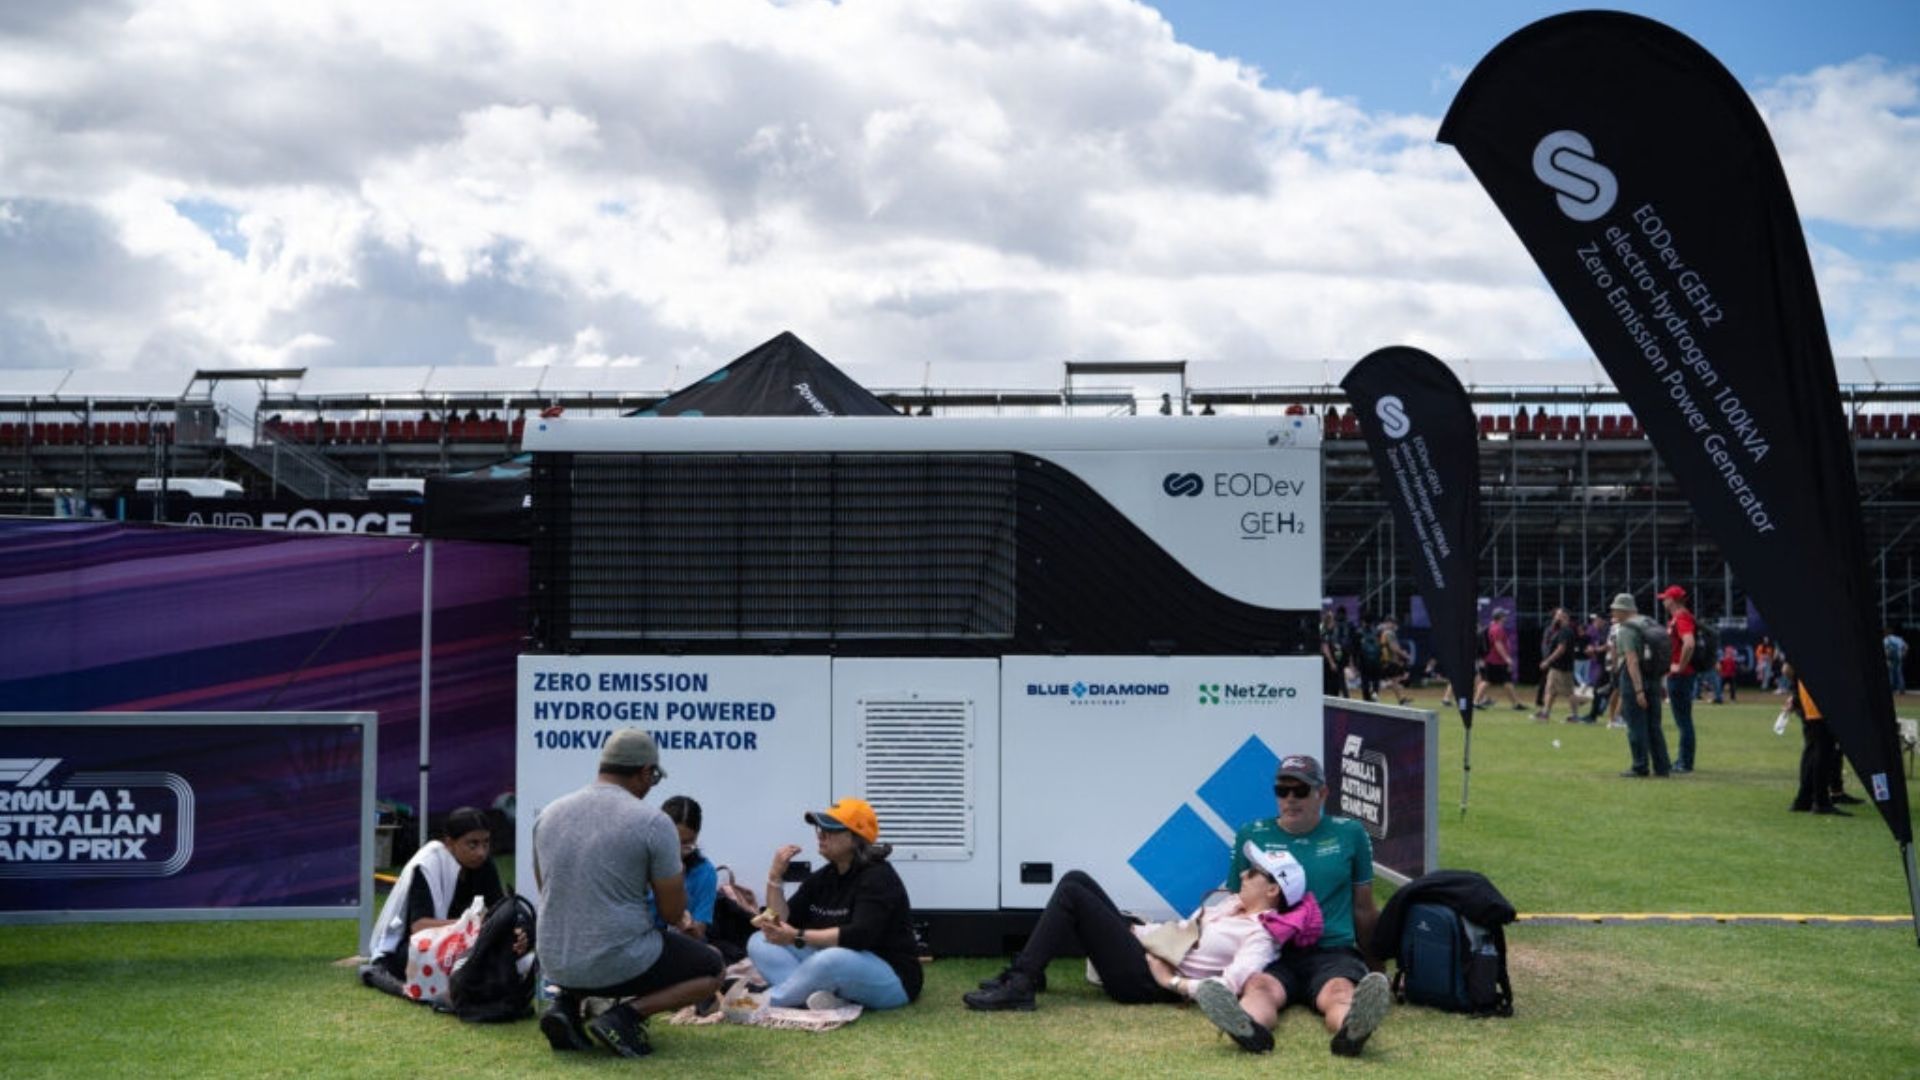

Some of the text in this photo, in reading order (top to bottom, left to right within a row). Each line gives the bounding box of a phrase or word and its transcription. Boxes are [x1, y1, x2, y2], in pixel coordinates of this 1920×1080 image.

[1632, 203, 1723, 328] EODev GEH2
[1605, 226, 1770, 463] electro-hydrogen 100kVA
[1576, 241, 1775, 532] Zero Emission Power Generator
[1214, 472, 1305, 497] EODev
[533, 672, 708, 693] ZERO EMISSION
[1026, 684, 1170, 696] BLUE DIAMOND
[1224, 683, 1297, 698] NetZero
[533, 701, 776, 722] HYDROGEN POWERED
[646, 731, 758, 750] NERATOR
[117, 790, 135, 811] 1
[68, 838, 147, 860] PRIX
